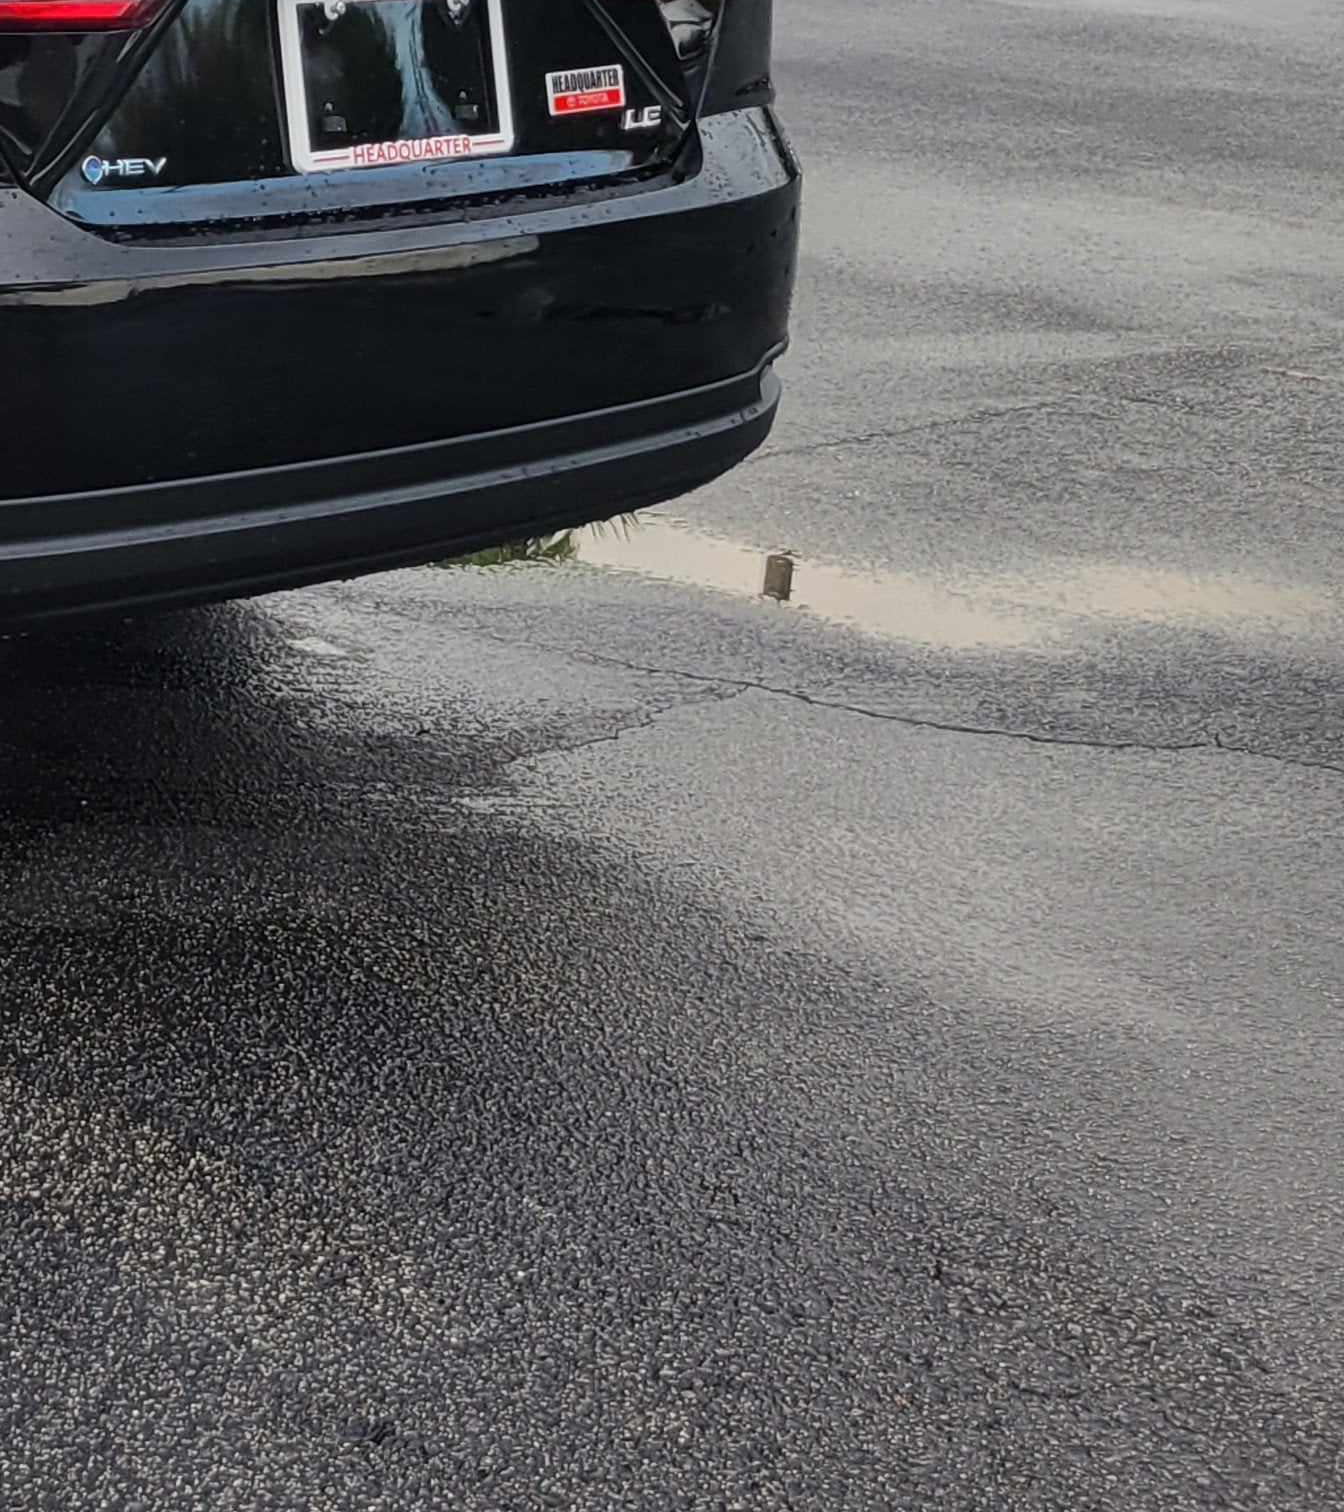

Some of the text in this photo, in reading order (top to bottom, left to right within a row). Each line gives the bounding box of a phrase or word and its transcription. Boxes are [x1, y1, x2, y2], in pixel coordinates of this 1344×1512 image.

[551, 68, 620, 94] HEADQUARTER
[578, 92, 610, 106] TOYOTA
[622, 105, 661, 130] LE
[353, 136, 471, 165] HEADQUARTER
[102, 157, 167, 176] HEV
